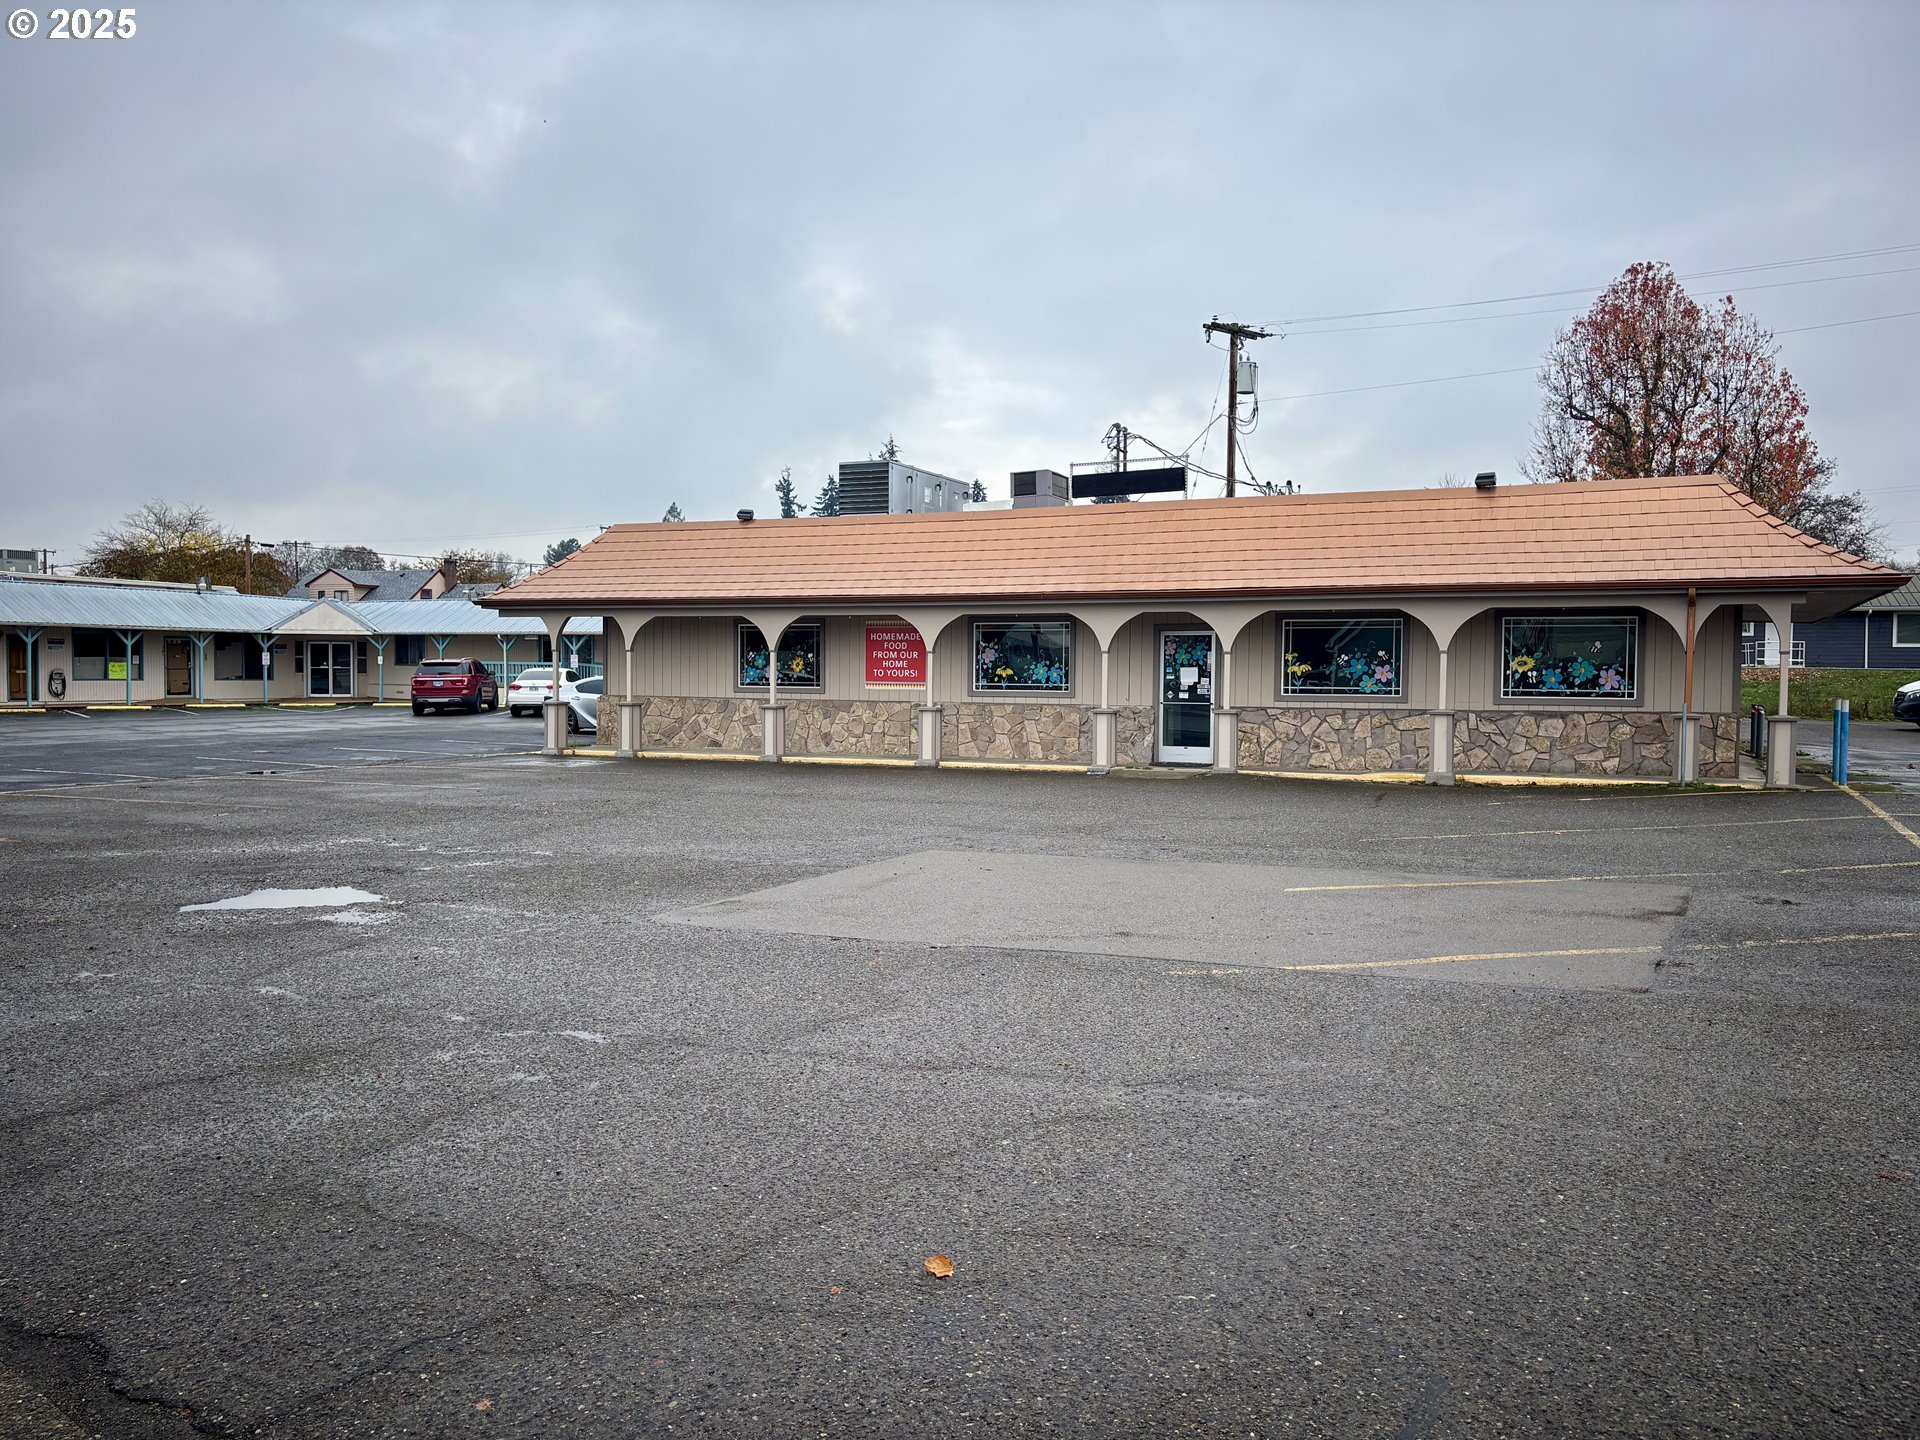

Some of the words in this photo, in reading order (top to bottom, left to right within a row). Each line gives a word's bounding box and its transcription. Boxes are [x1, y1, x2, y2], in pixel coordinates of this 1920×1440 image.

[870, 632, 921, 641] HOMEMADE
[884, 641, 908, 650] FOOD
[872, 651, 898, 659] FROM
[900, 651, 919, 659] OUR
[882, 660, 908, 668] HOME
[873, 669, 884, 677] TO
